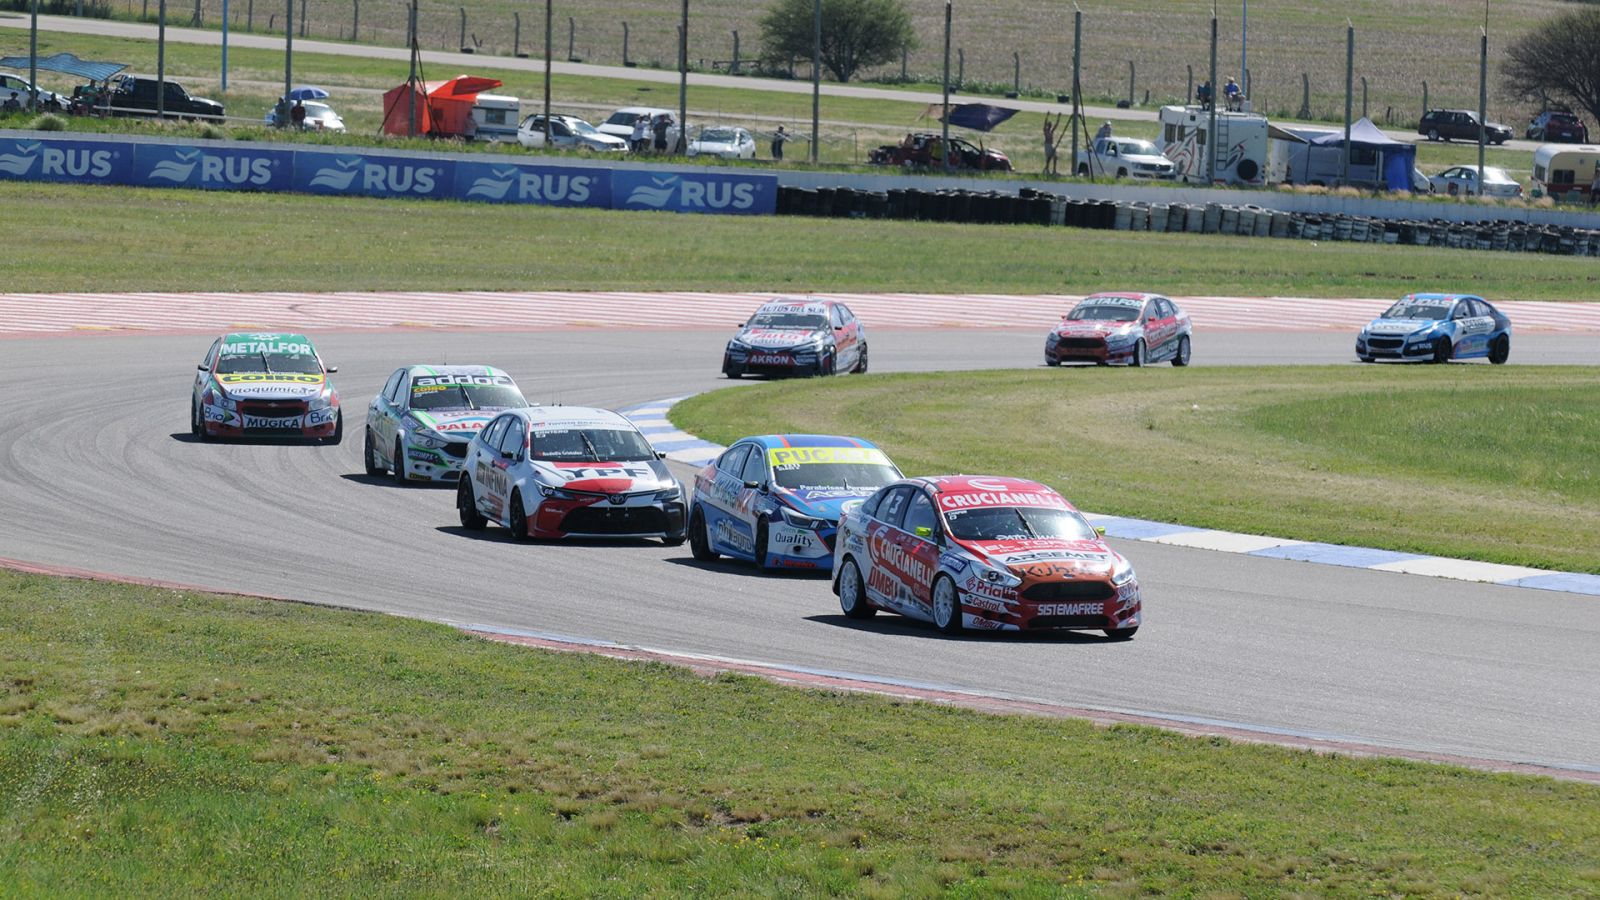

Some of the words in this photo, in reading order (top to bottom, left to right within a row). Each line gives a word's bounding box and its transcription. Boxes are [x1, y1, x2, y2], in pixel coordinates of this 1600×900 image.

[42, 148, 112, 177] RUS
[202, 155, 272, 184] RUS
[363, 163, 435, 193] RUS
[519, 172, 590, 201] RUS
[681, 180, 754, 208] RUS
[222, 342, 311, 354] METALFOR
[751, 355, 790, 365] AKRON
[561, 468, 650, 479] YPF
[941, 493, 1062, 508] CRUCIANELLI
[775, 533, 813, 547] Quality
[1036, 603, 1104, 616] SISTEMAFREE
